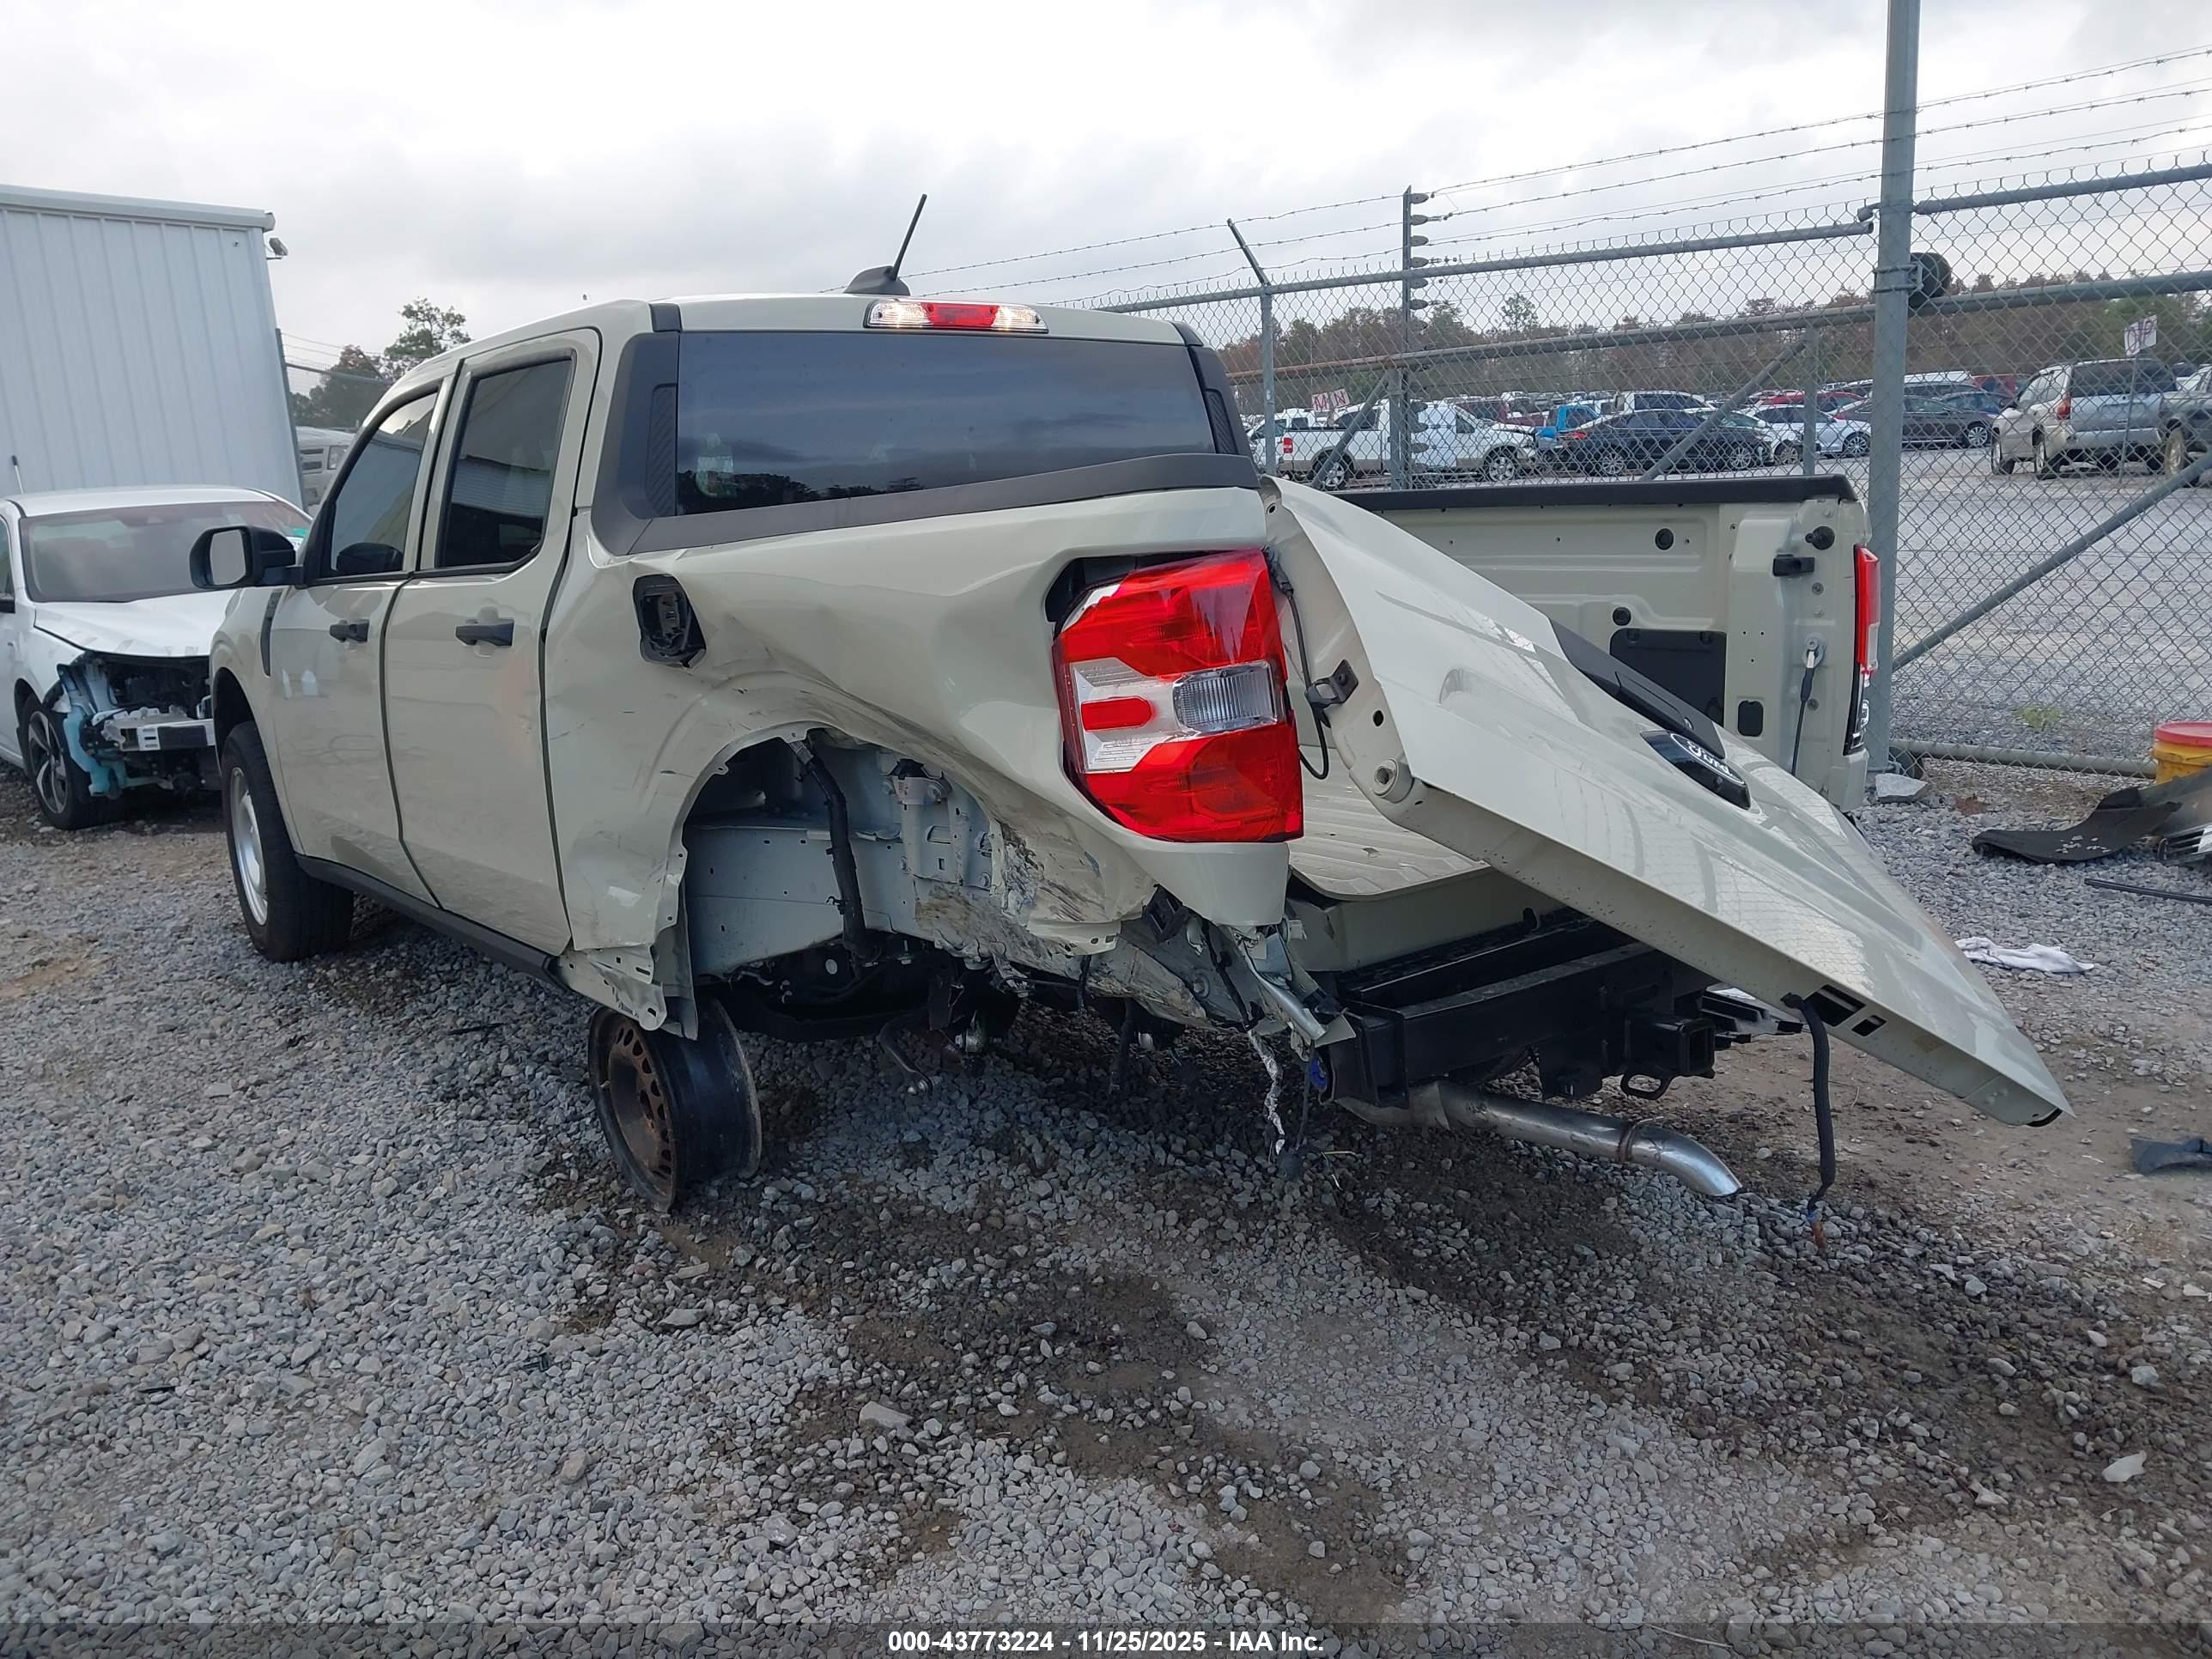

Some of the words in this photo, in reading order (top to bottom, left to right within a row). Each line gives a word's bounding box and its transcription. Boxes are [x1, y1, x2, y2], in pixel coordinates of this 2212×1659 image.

[1314, 395, 1328, 411] M
[1334, 391, 1346, 405] N
[1687, 739, 1734, 777] Ford
